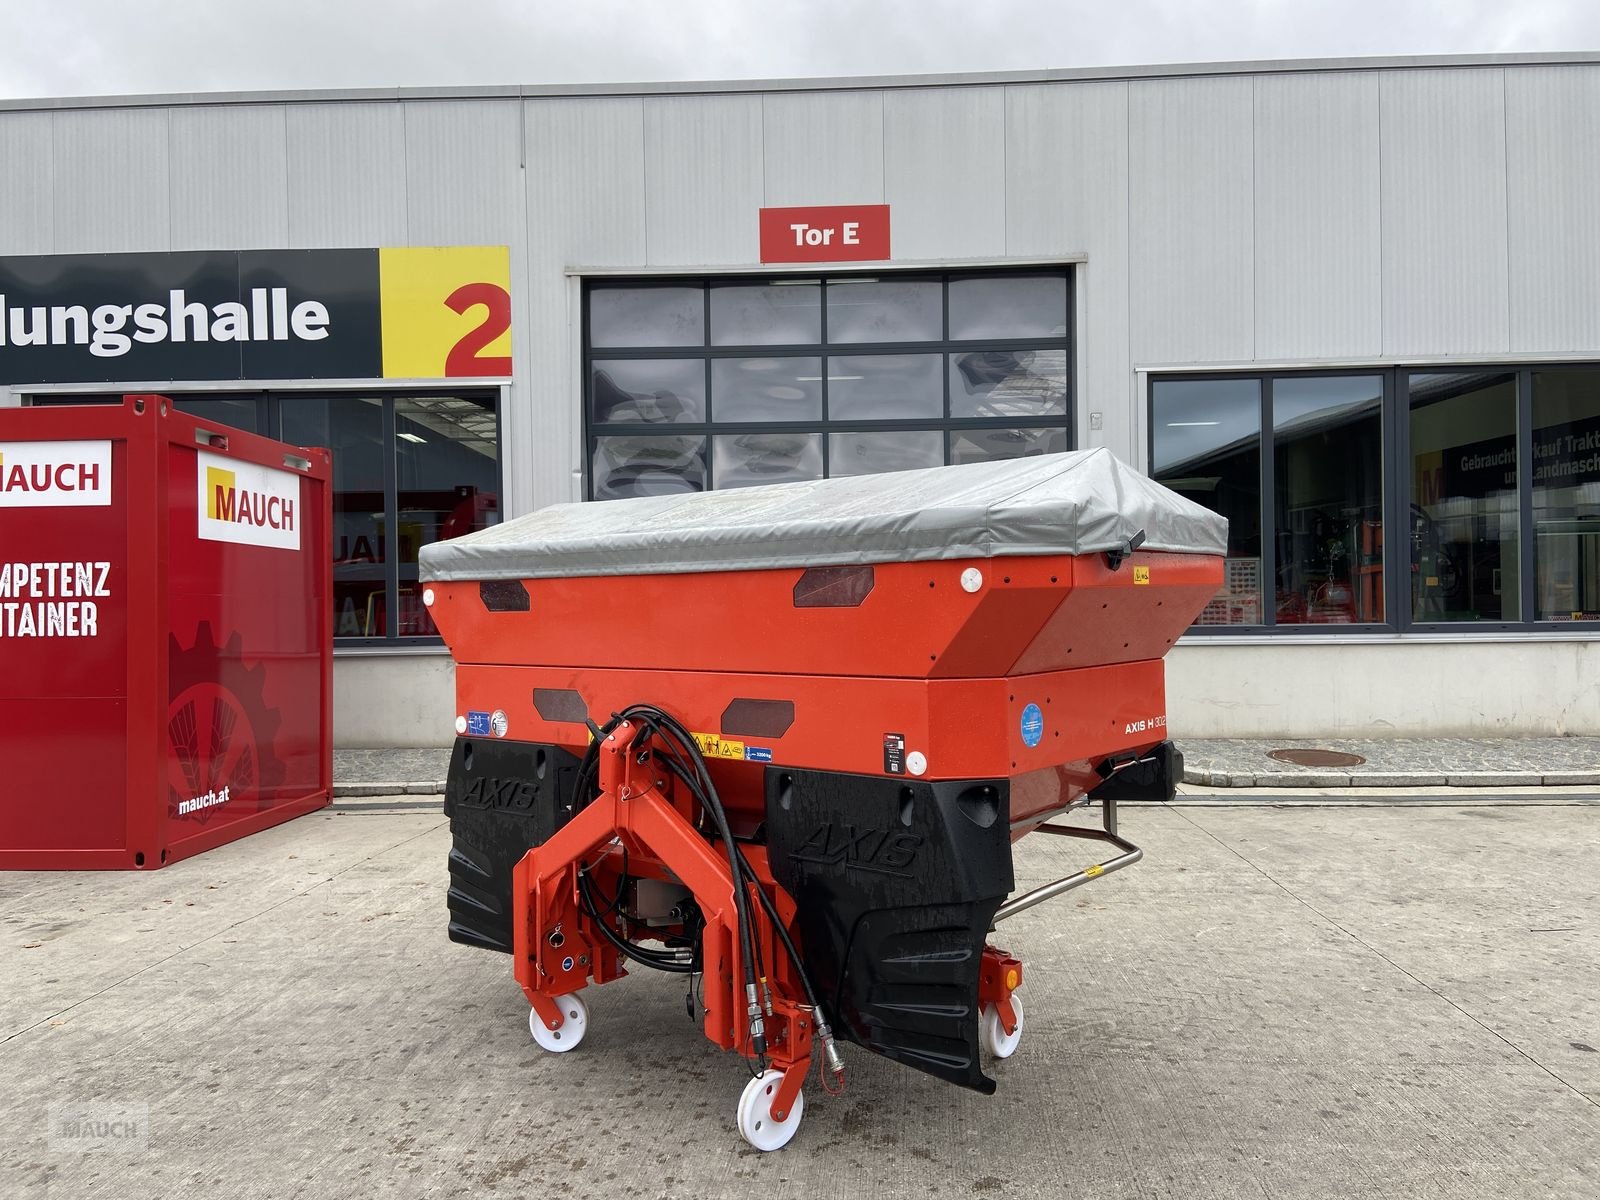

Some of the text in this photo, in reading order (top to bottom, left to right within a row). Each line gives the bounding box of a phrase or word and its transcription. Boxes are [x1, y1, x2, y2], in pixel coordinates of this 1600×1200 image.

[790, 222, 860, 246] Tor E
[443, 282, 513, 378] 2
[0, 463, 99, 492] AUCH
[215, 485, 294, 531] MAUCH
[0, 602, 97, 637] TAINER
[1125, 720, 1146, 735] AXIS
[1148, 718, 1154, 729] H
[178, 785, 230, 815] mauch.at
[460, 776, 539, 812] AXIS
[796, 822, 926, 870] AXIS
